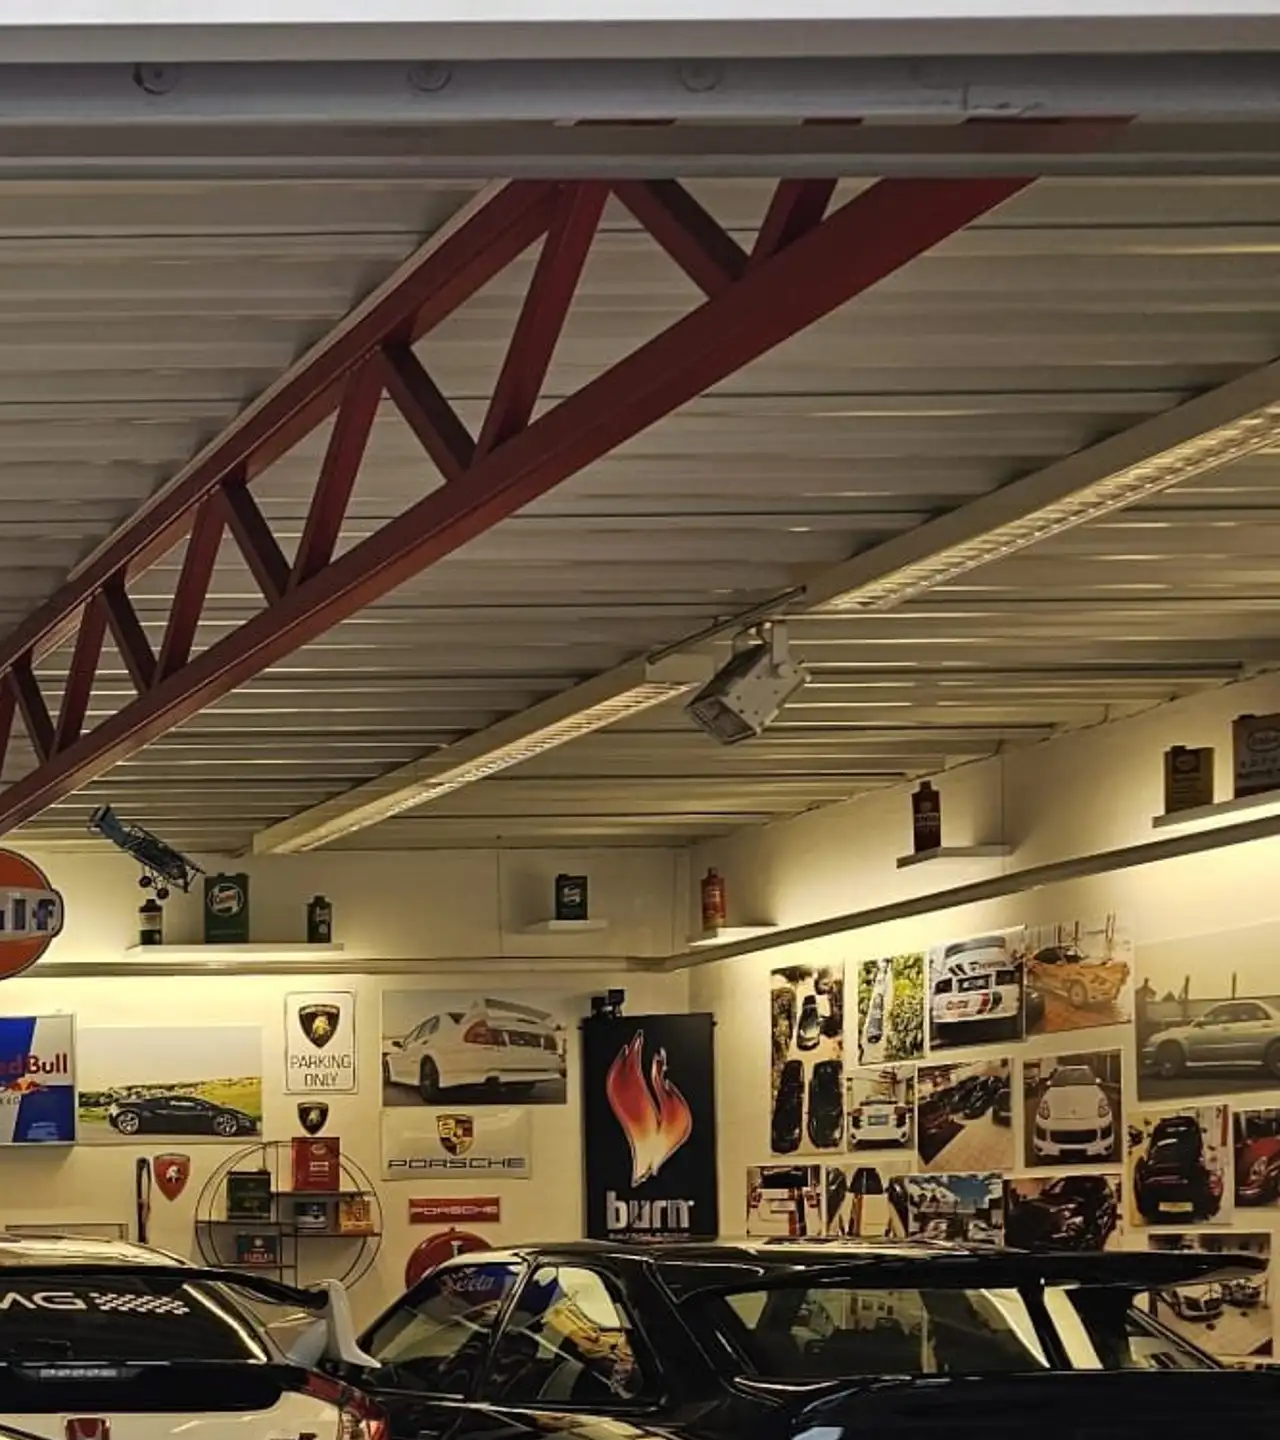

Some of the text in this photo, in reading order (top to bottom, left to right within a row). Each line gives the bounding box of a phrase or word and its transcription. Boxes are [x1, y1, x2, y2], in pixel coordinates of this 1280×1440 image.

[27, 1053, 67, 1074] Bull
[290, 1054, 352, 1069] PARKING
[304, 1073, 338, 1087] ONLY
[388, 1157, 526, 1169] PORSCHE
[410, 1205, 498, 1215] PORSCHE
[606, 1190, 689, 1230] burn
